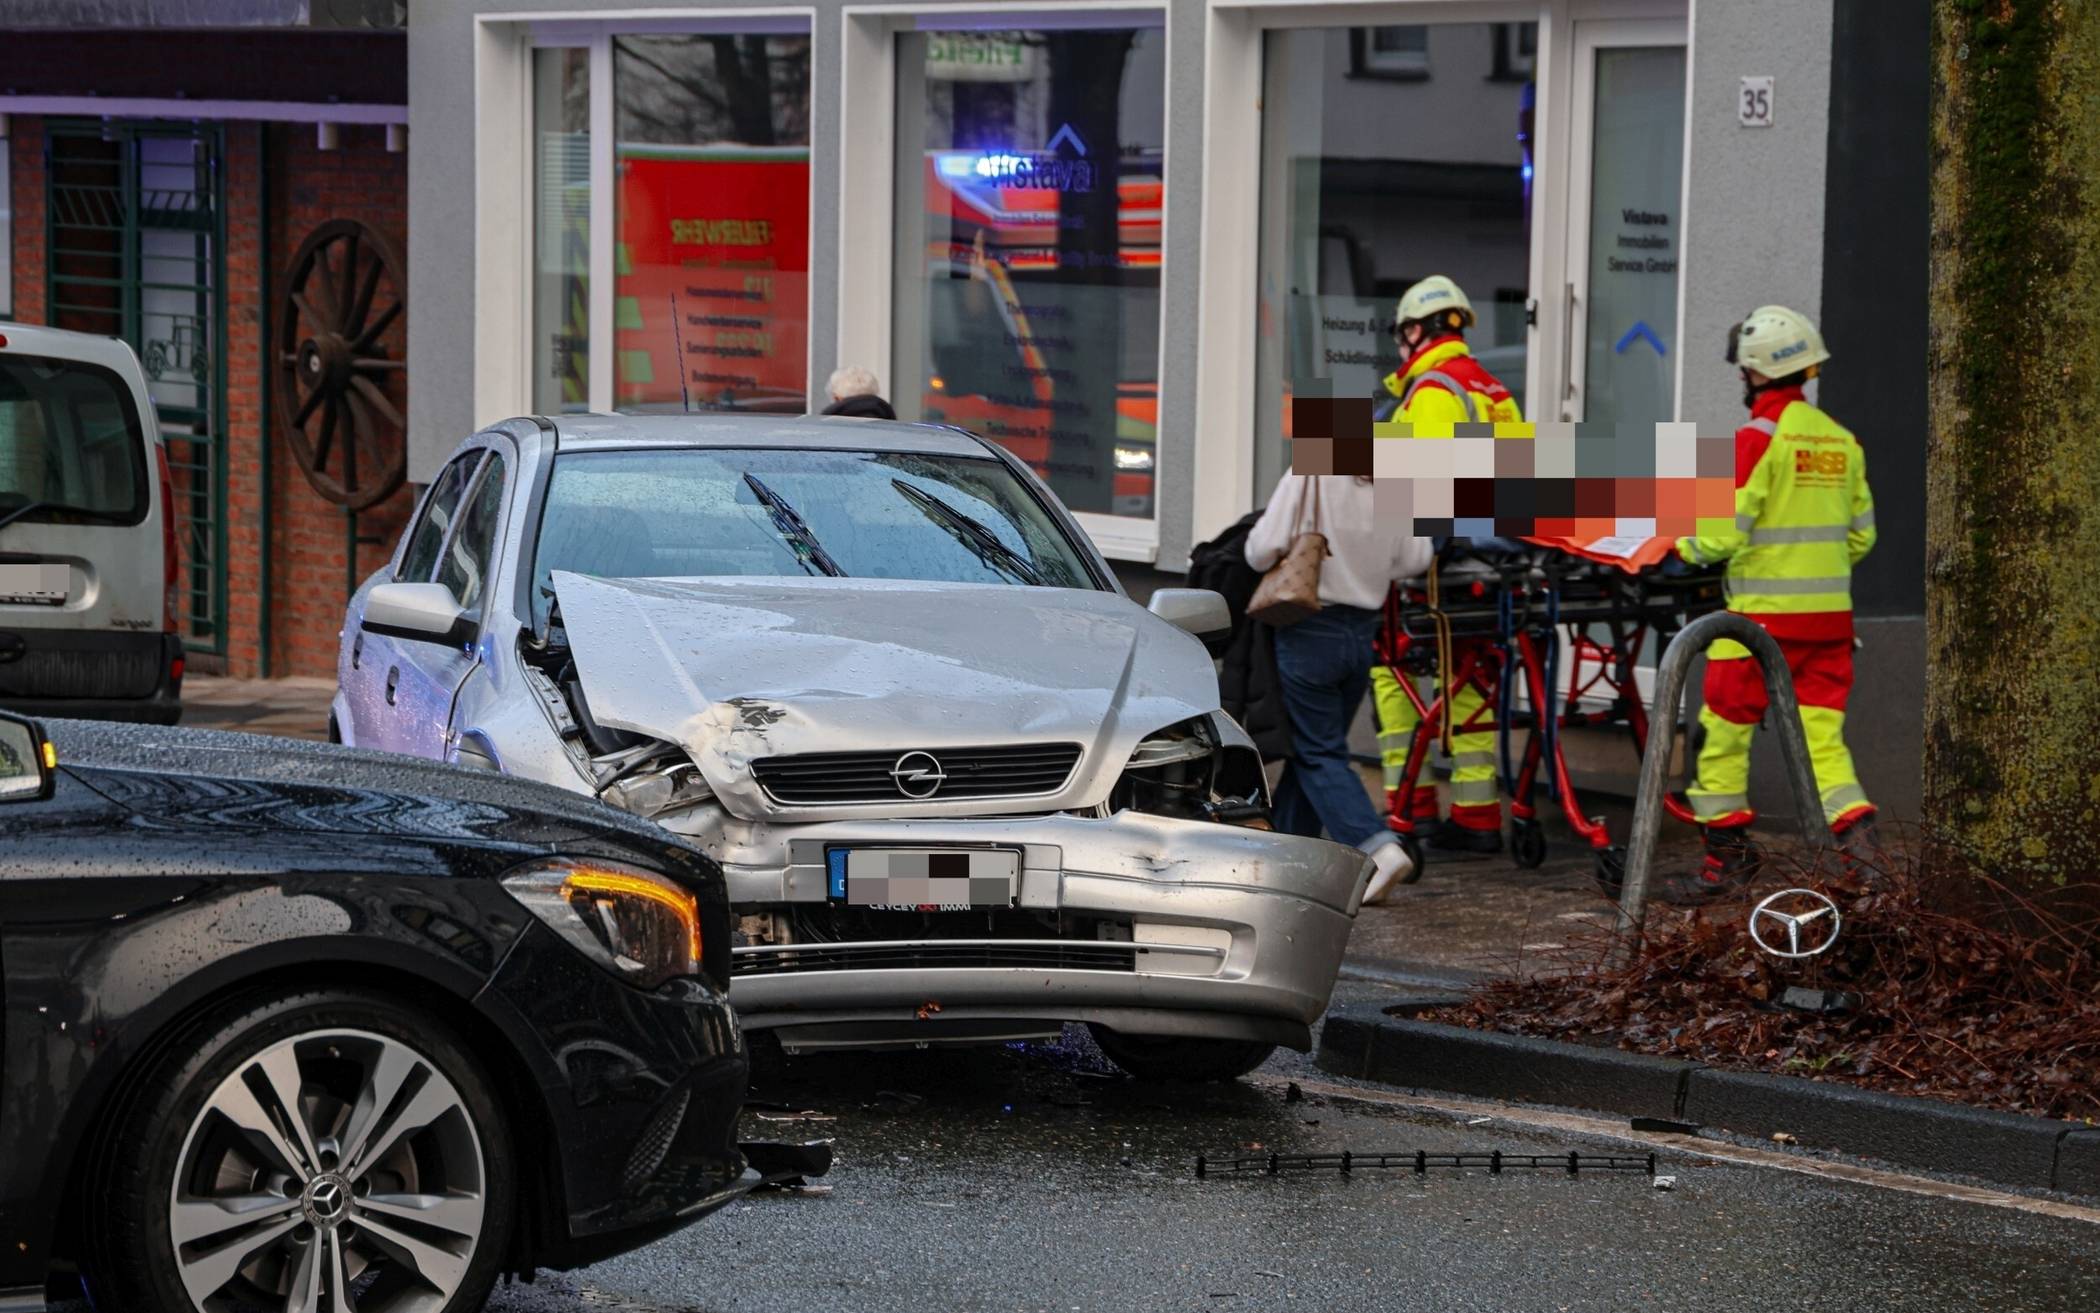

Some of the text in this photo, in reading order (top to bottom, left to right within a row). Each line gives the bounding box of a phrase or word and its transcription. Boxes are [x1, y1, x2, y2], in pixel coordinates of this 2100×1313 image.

[1743, 88, 1769, 120] 35
[986, 151, 1092, 193] Vistava
[1622, 208, 1668, 226] Vistava
[1608, 255, 1643, 273] Service
[1322, 316, 1364, 336] Heizung
[1368, 317, 1375, 332] &
